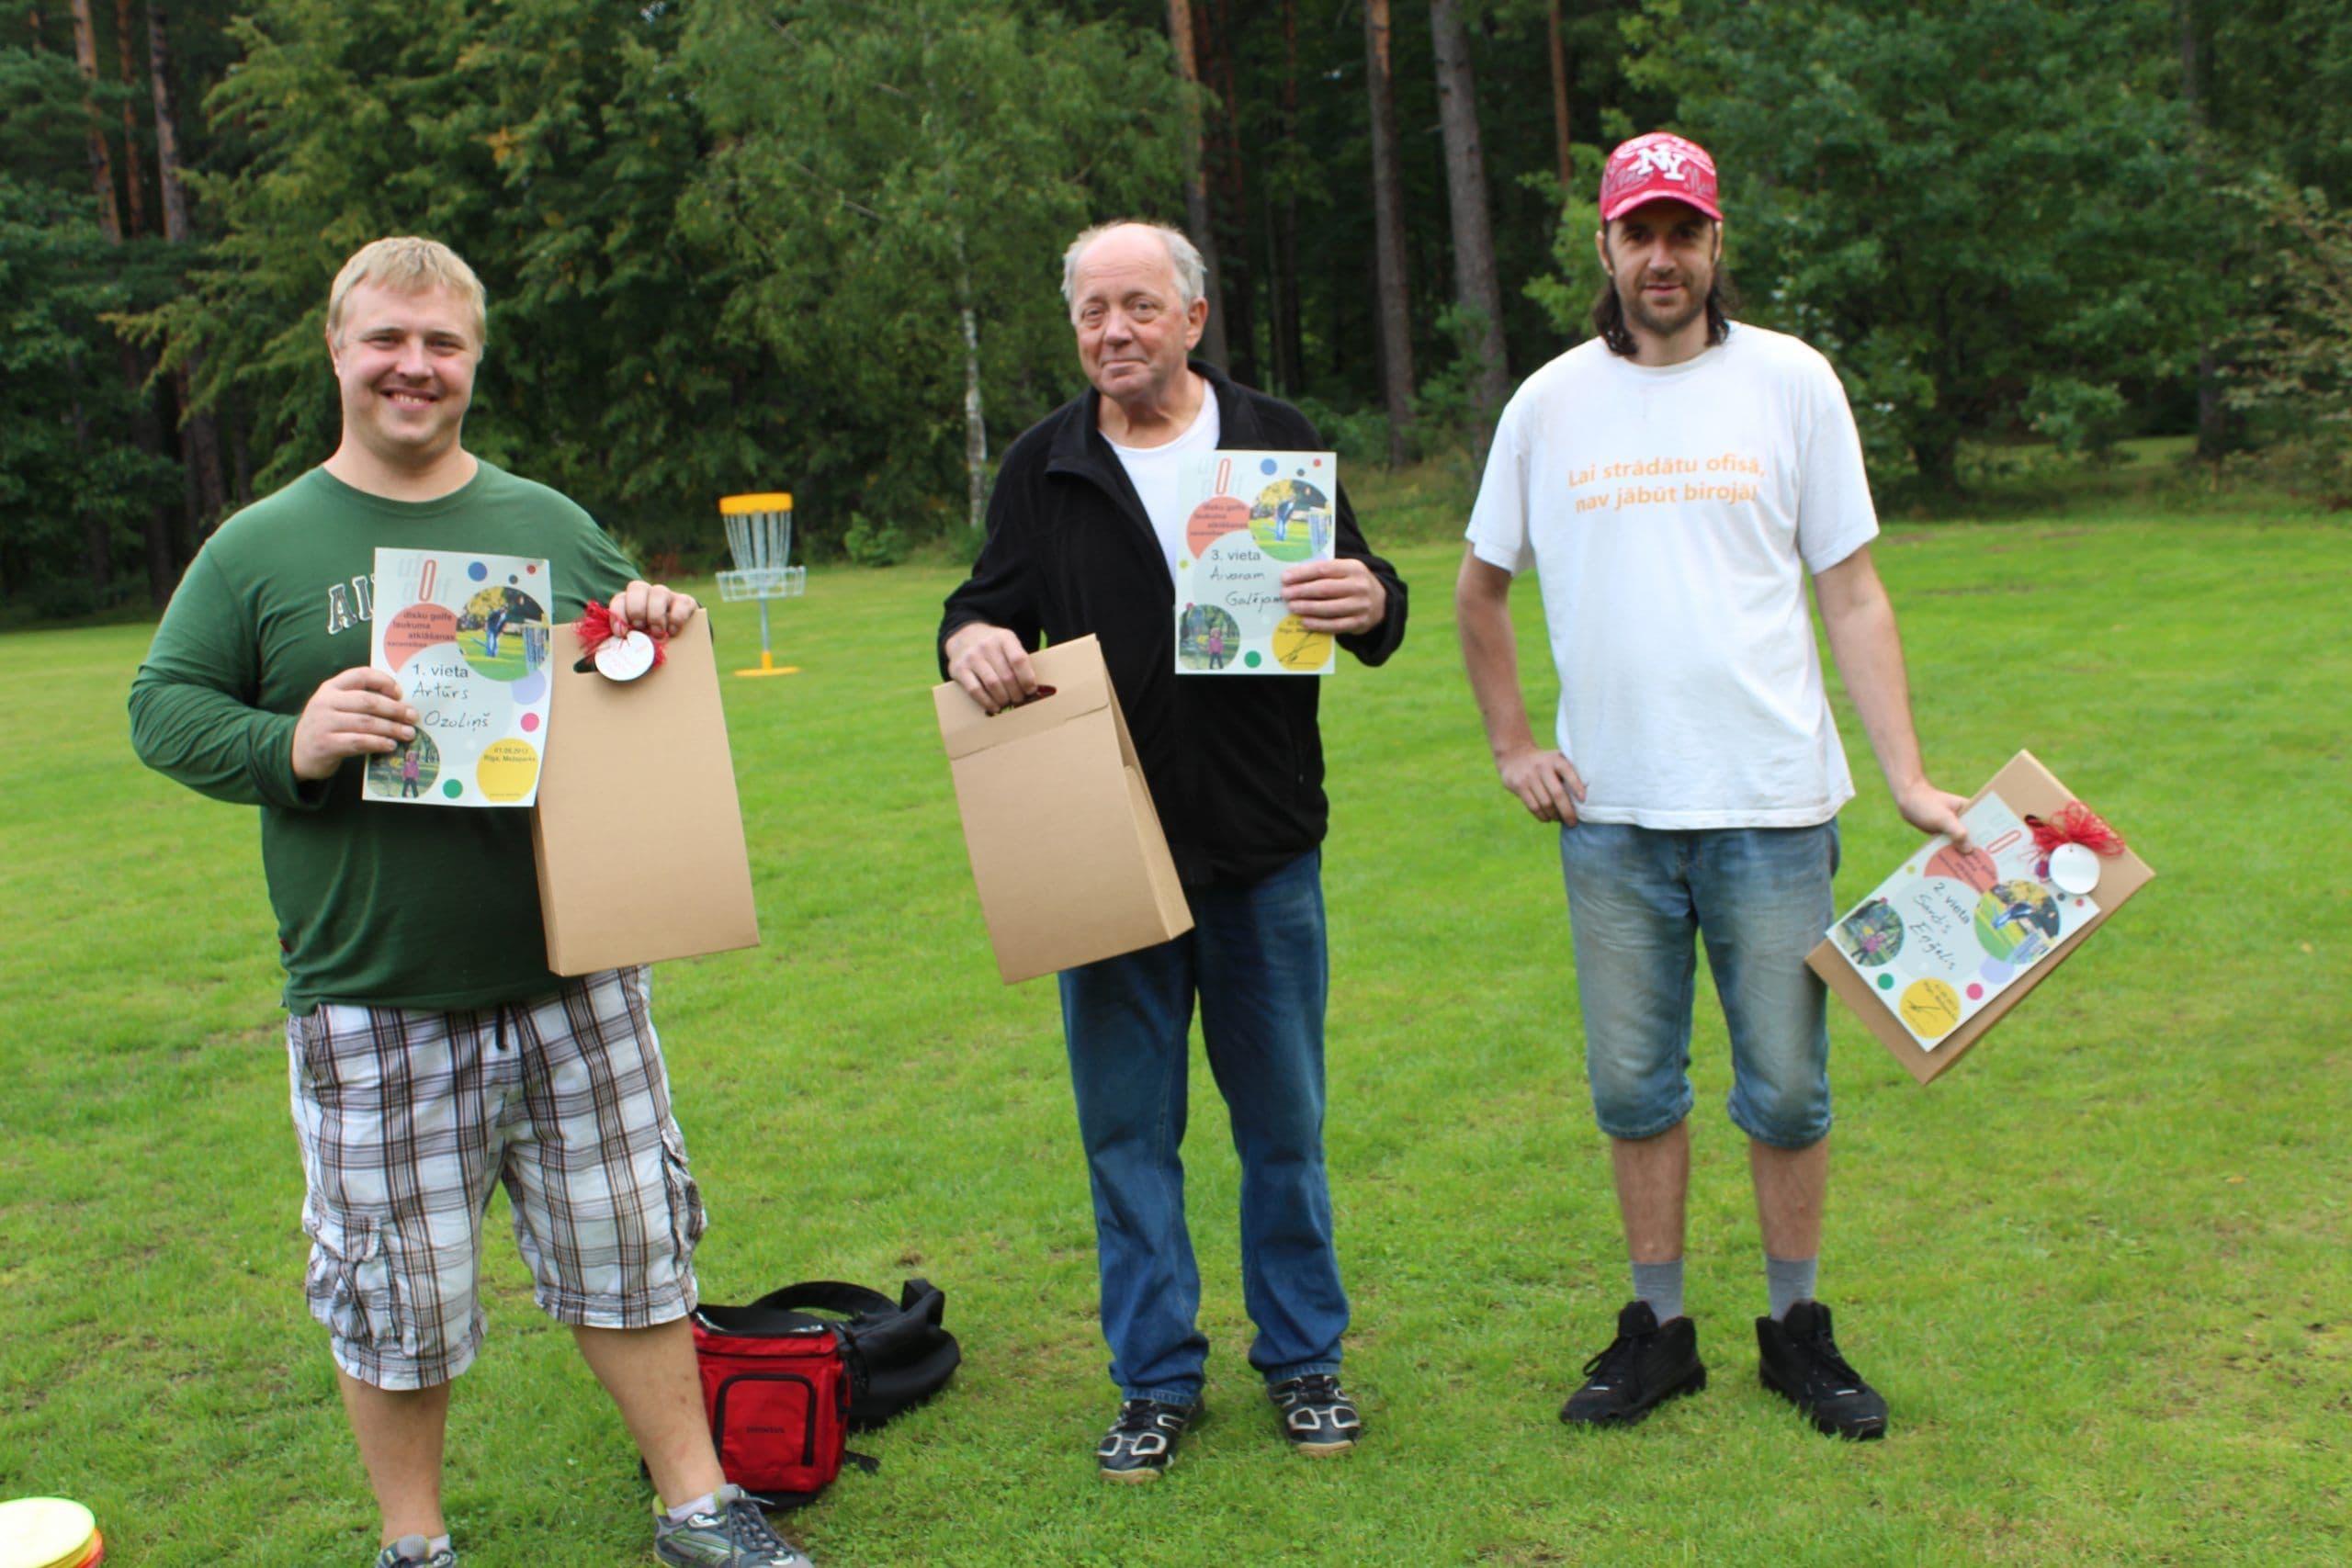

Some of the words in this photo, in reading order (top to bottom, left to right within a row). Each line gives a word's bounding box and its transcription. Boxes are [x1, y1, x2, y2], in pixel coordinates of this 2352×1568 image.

[1568, 464, 1596, 487] Lai
[1602, 457, 1698, 479] strādātu
[1575, 493, 1610, 513] nav
[1614, 486, 1678, 511] jābūt
[1227, 550, 1261, 561] vieta
[413, 663, 425, 675] 1.
[431, 665, 469, 678] vieta
[413, 681, 469, 699] Artūrs
[1946, 896, 1971, 924] vieta
